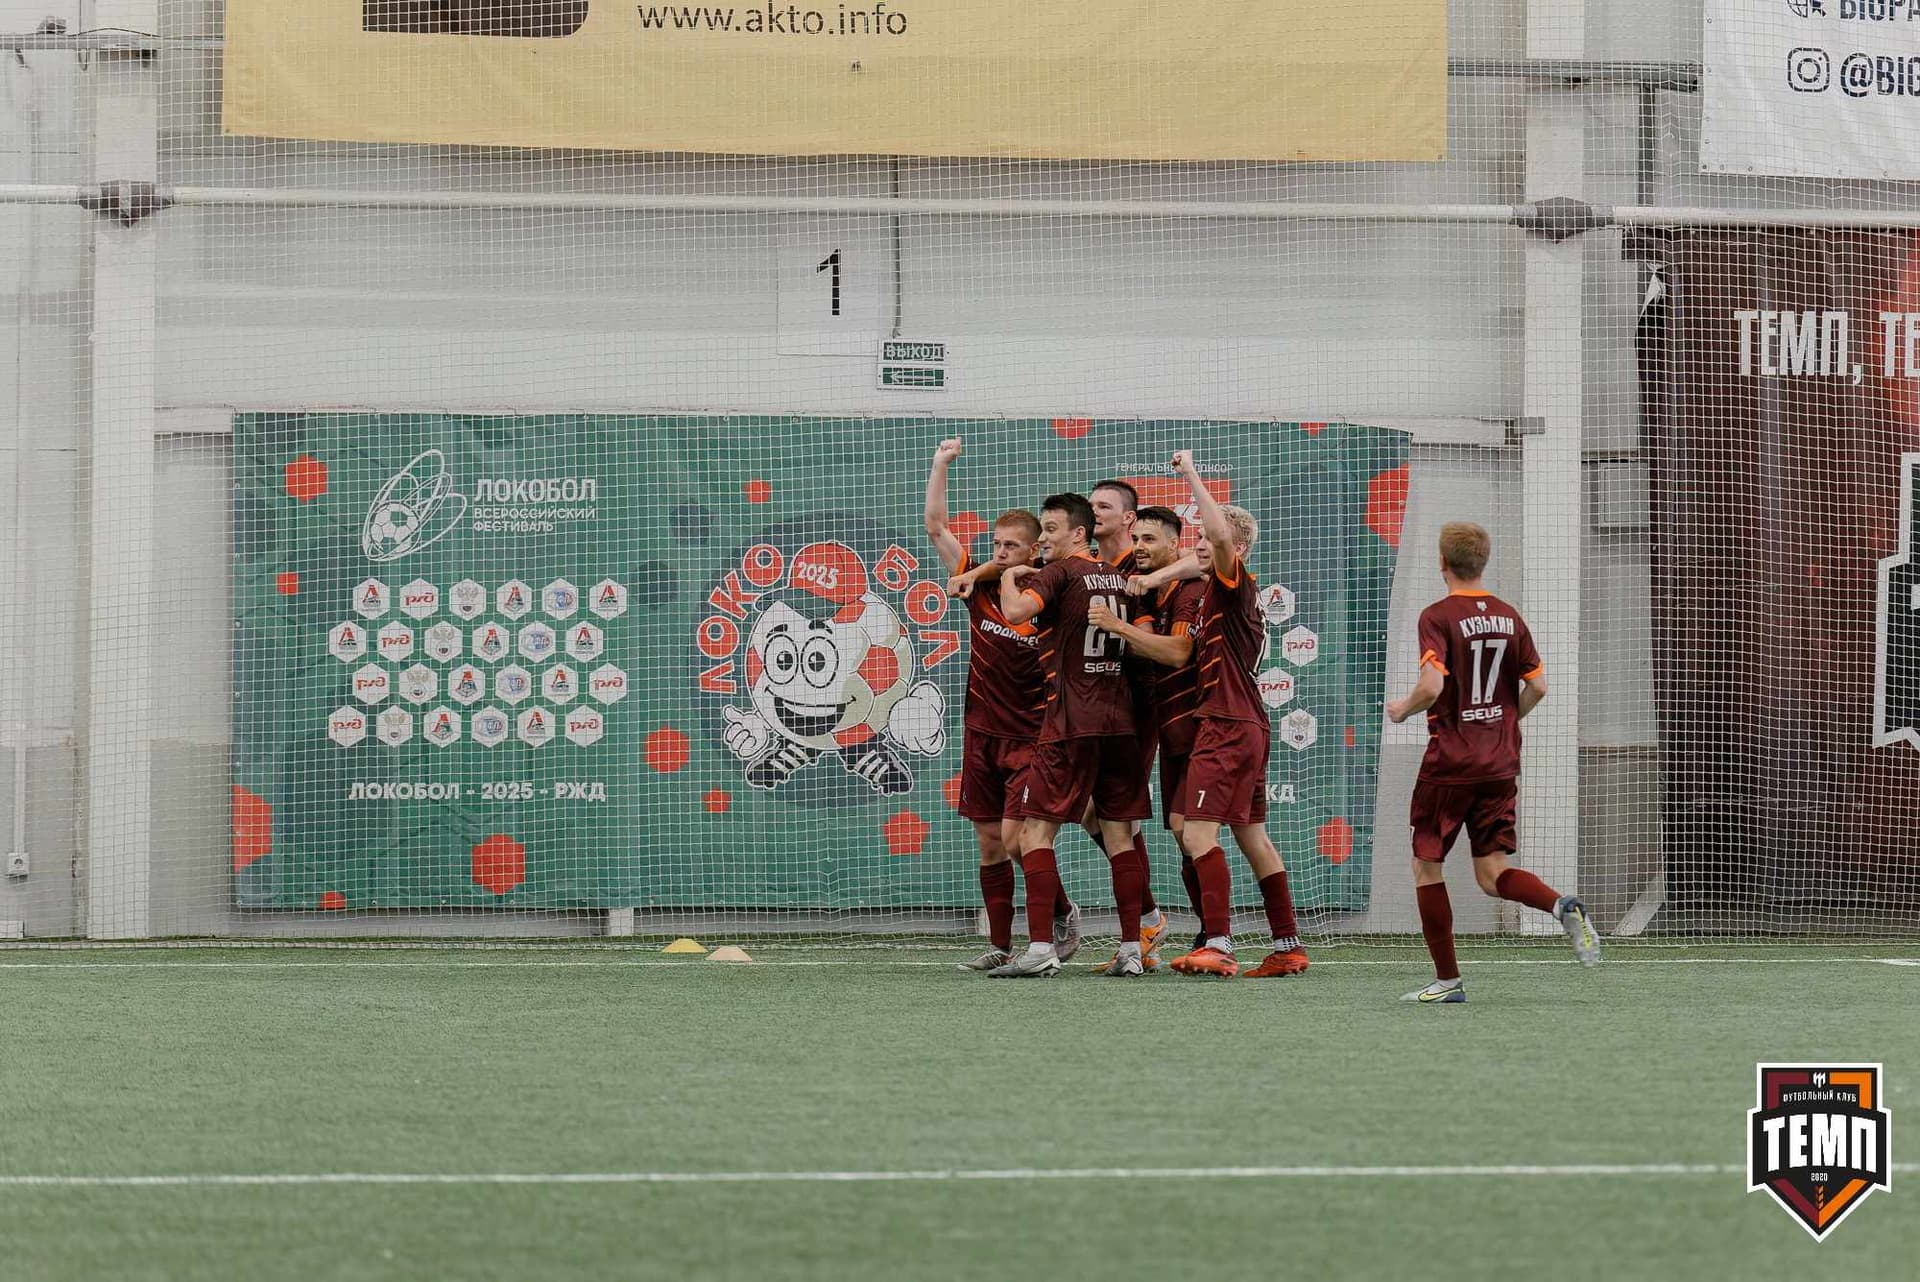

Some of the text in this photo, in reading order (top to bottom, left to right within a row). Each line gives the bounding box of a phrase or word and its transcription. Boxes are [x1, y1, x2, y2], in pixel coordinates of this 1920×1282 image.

[638, 1, 907, 35] www.akto.info
[816, 248, 841, 316] 1
[886, 346, 943, 361] ВЫХОД
[1734, 311, 1863, 385] ТЕМП,
[474, 479, 596, 502] ЛОКОБОЛ
[474, 506, 596, 519] ВСЕРОССИЙСКИЙ
[473, 521, 554, 532] ФЕСТИВАЛЬ
[798, 562, 839, 589] 2025
[697, 543, 786, 694] ЛОКО
[1460, 615, 1514, 638] КУЗЬКИН
[1470, 639, 1507, 705] 17
[1462, 704, 1503, 722] SEUS
[349, 783, 460, 800] ЛОКОБОЛ
[481, 782, 535, 800] 2025
[555, 783, 607, 802] РЖД
[1197, 790, 1206, 809] 7
